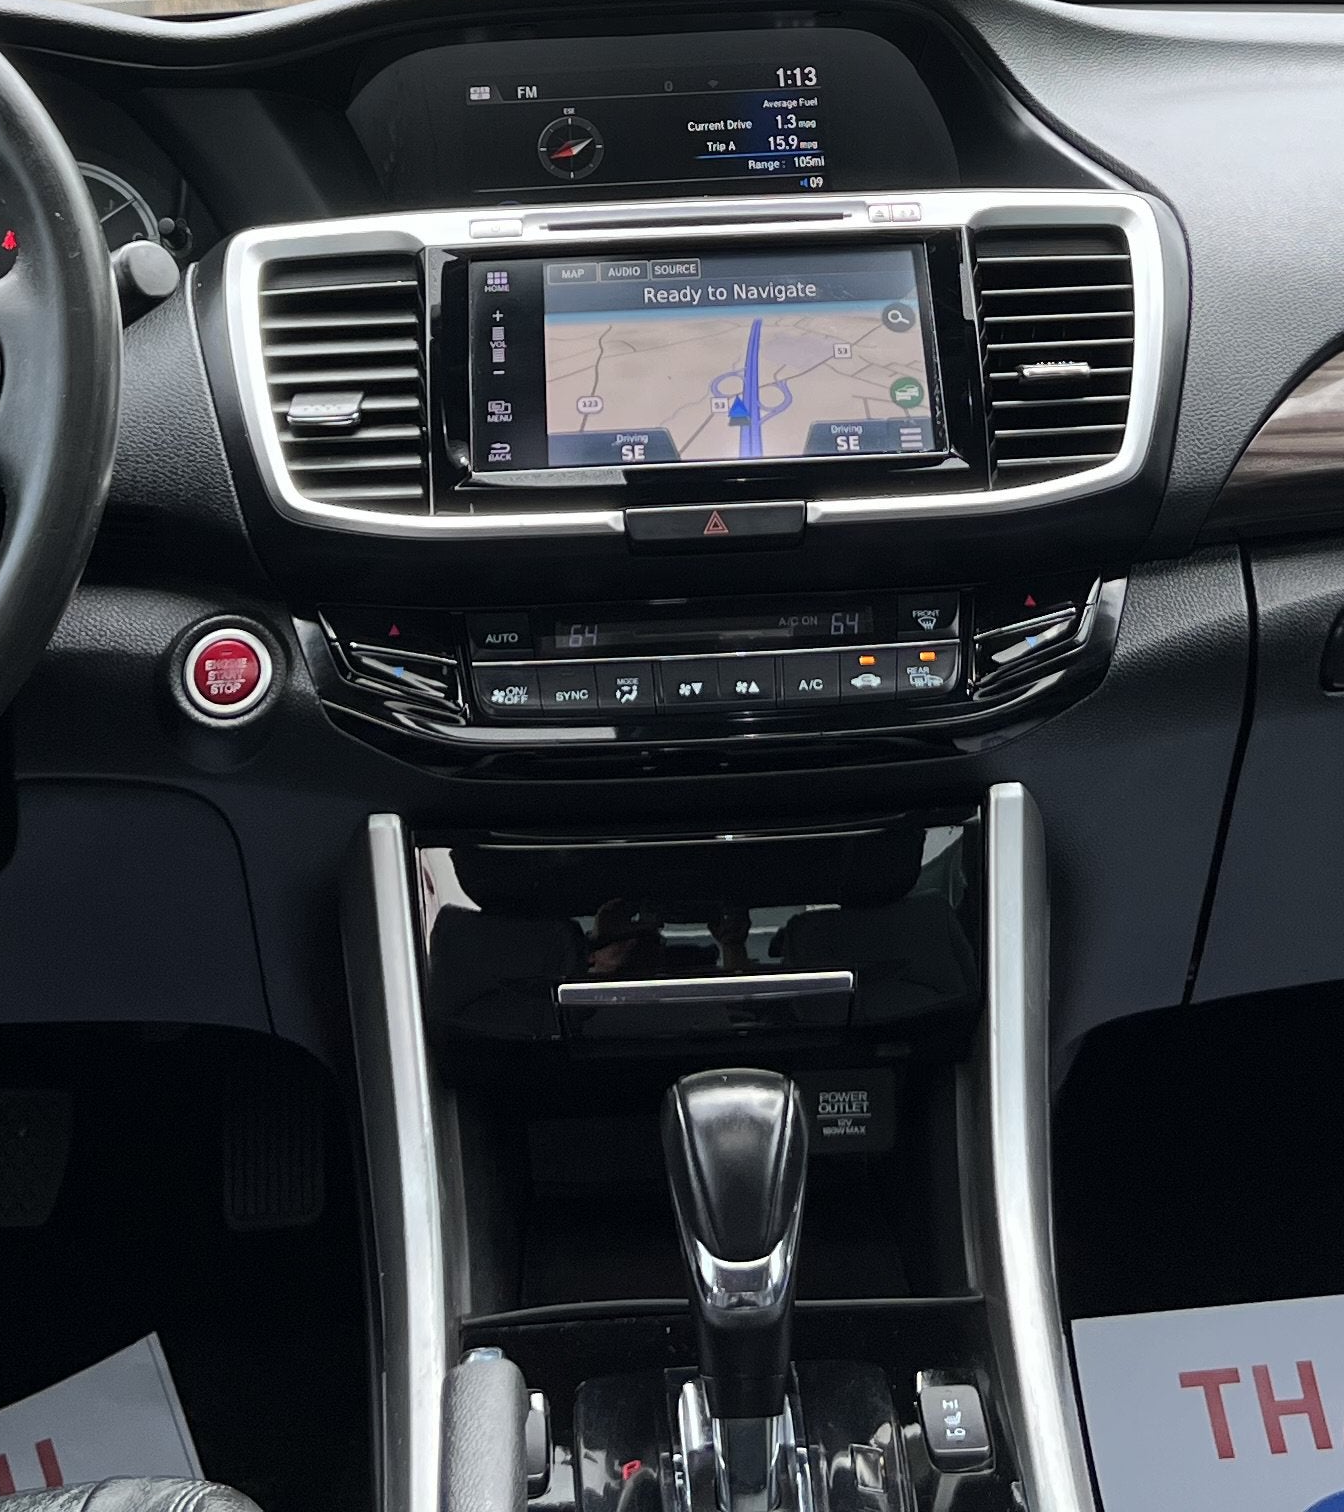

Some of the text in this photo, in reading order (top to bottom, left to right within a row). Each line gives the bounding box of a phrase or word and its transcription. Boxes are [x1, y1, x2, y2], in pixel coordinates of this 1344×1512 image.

[776, 66, 818, 87] 1:13
[517, 85, 538, 99] FM
[763, 97, 818, 110] Average Fuel
[687, 119, 725, 132] Current
[727, 118, 753, 130] Drive
[775, 113, 797, 129] 1.3
[706, 141, 727, 153] Trip
[728, 141, 737, 151] A
[768, 135, 798, 151] 15.9
[748, 156, 825, 171] Range 105mi
[809, 176, 824, 189] 09
[561, 268, 585, 279] MAP
[607, 266, 641, 278] AUDIO
[654, 263, 697, 276] SOURCE
[484, 284, 510, 293] HOME
[643, 282, 817, 305] Ready to Navigate
[489, 340, 508, 349] VOL
[487, 414, 513, 423] MENU
[830, 424, 863, 435] Driving
[616, 433, 649, 445] Driving
[836, 435, 860, 452] SE
[488, 452, 512, 462] BACK
[621, 444, 646, 462] SE
[912, 609, 941, 618] FRONT
[778, 615, 818, 627] A/C ON
[830, 612, 860, 635] 64
[485, 632, 519, 644] AUTO
[568, 624, 598, 648] 64
[207, 668, 245, 681] START
[906, 666, 930, 675] REAR
[616, 677, 639, 685] MODE
[798, 678, 824, 691] A/C
[210, 682, 242, 695] STOP
[505, 686, 528, 696] ON/
[505, 694, 529, 704] OFF
[555, 689, 589, 702] SYNC
[819, 1090, 868, 1102] POWER
[818, 1101, 870, 1114] OUTLET
